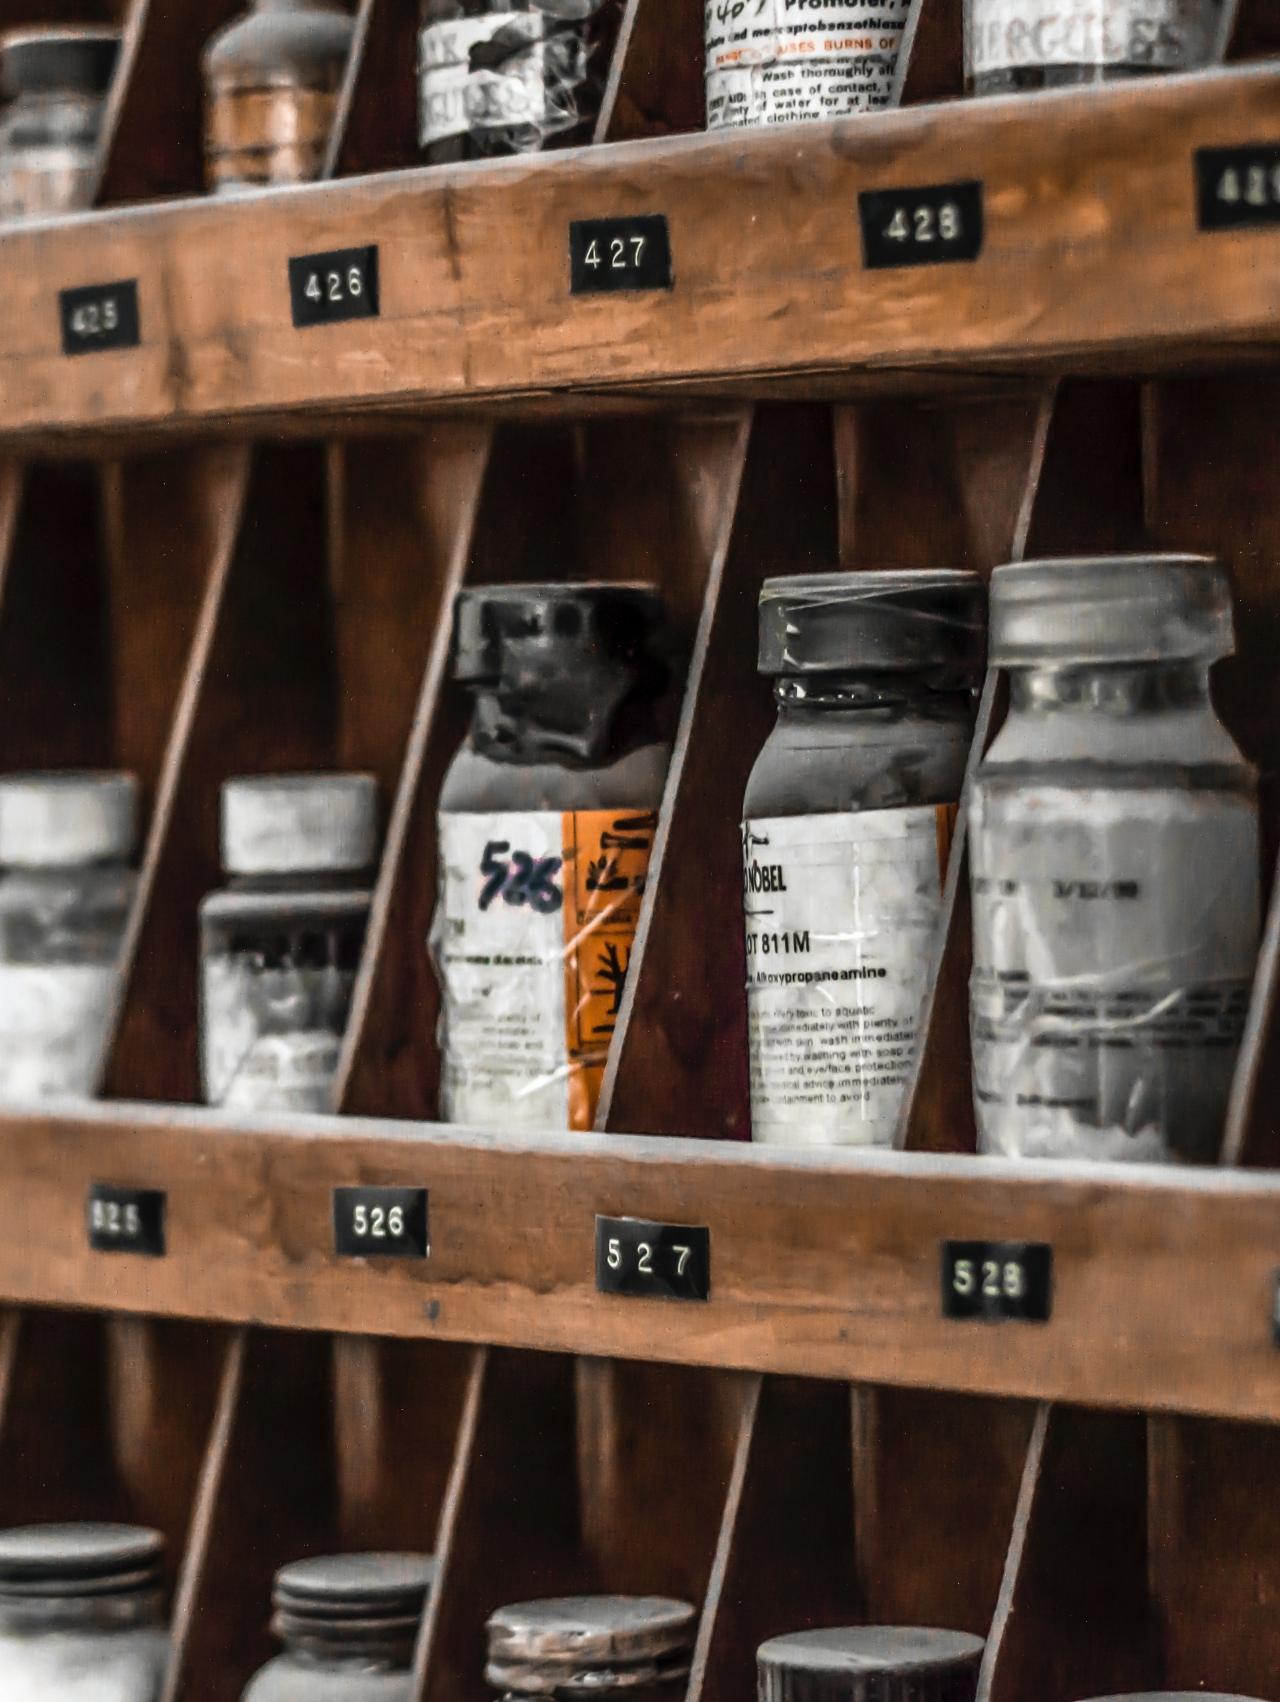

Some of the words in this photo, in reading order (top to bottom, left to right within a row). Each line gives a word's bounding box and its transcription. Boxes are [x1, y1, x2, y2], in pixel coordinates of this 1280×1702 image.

[824, 38, 873, 51] BURNS
[763, 70, 795, 82] Wash
[801, 64, 873, 79] thoroughly
[773, 88, 802, 98] case
[809, 83, 822, 95] of
[828, 81, 881, 94] contact,
[775, 99, 811, 109] water
[820, 95, 839, 106] for
[847, 94, 860, 105] at
[882, 203, 960, 242] 428
[584, 237, 645, 269] 427
[305, 267, 362, 302] 426
[478, 841, 563, 913] 526
[761, 931, 810, 955] 811M
[863, 1018, 898, 1030] plenty
[820, 1036, 848, 1046] wash
[876, 1047, 904, 1057] soap
[354, 1205, 403, 1236] 526
[952, 1259, 1024, 1298] 528
